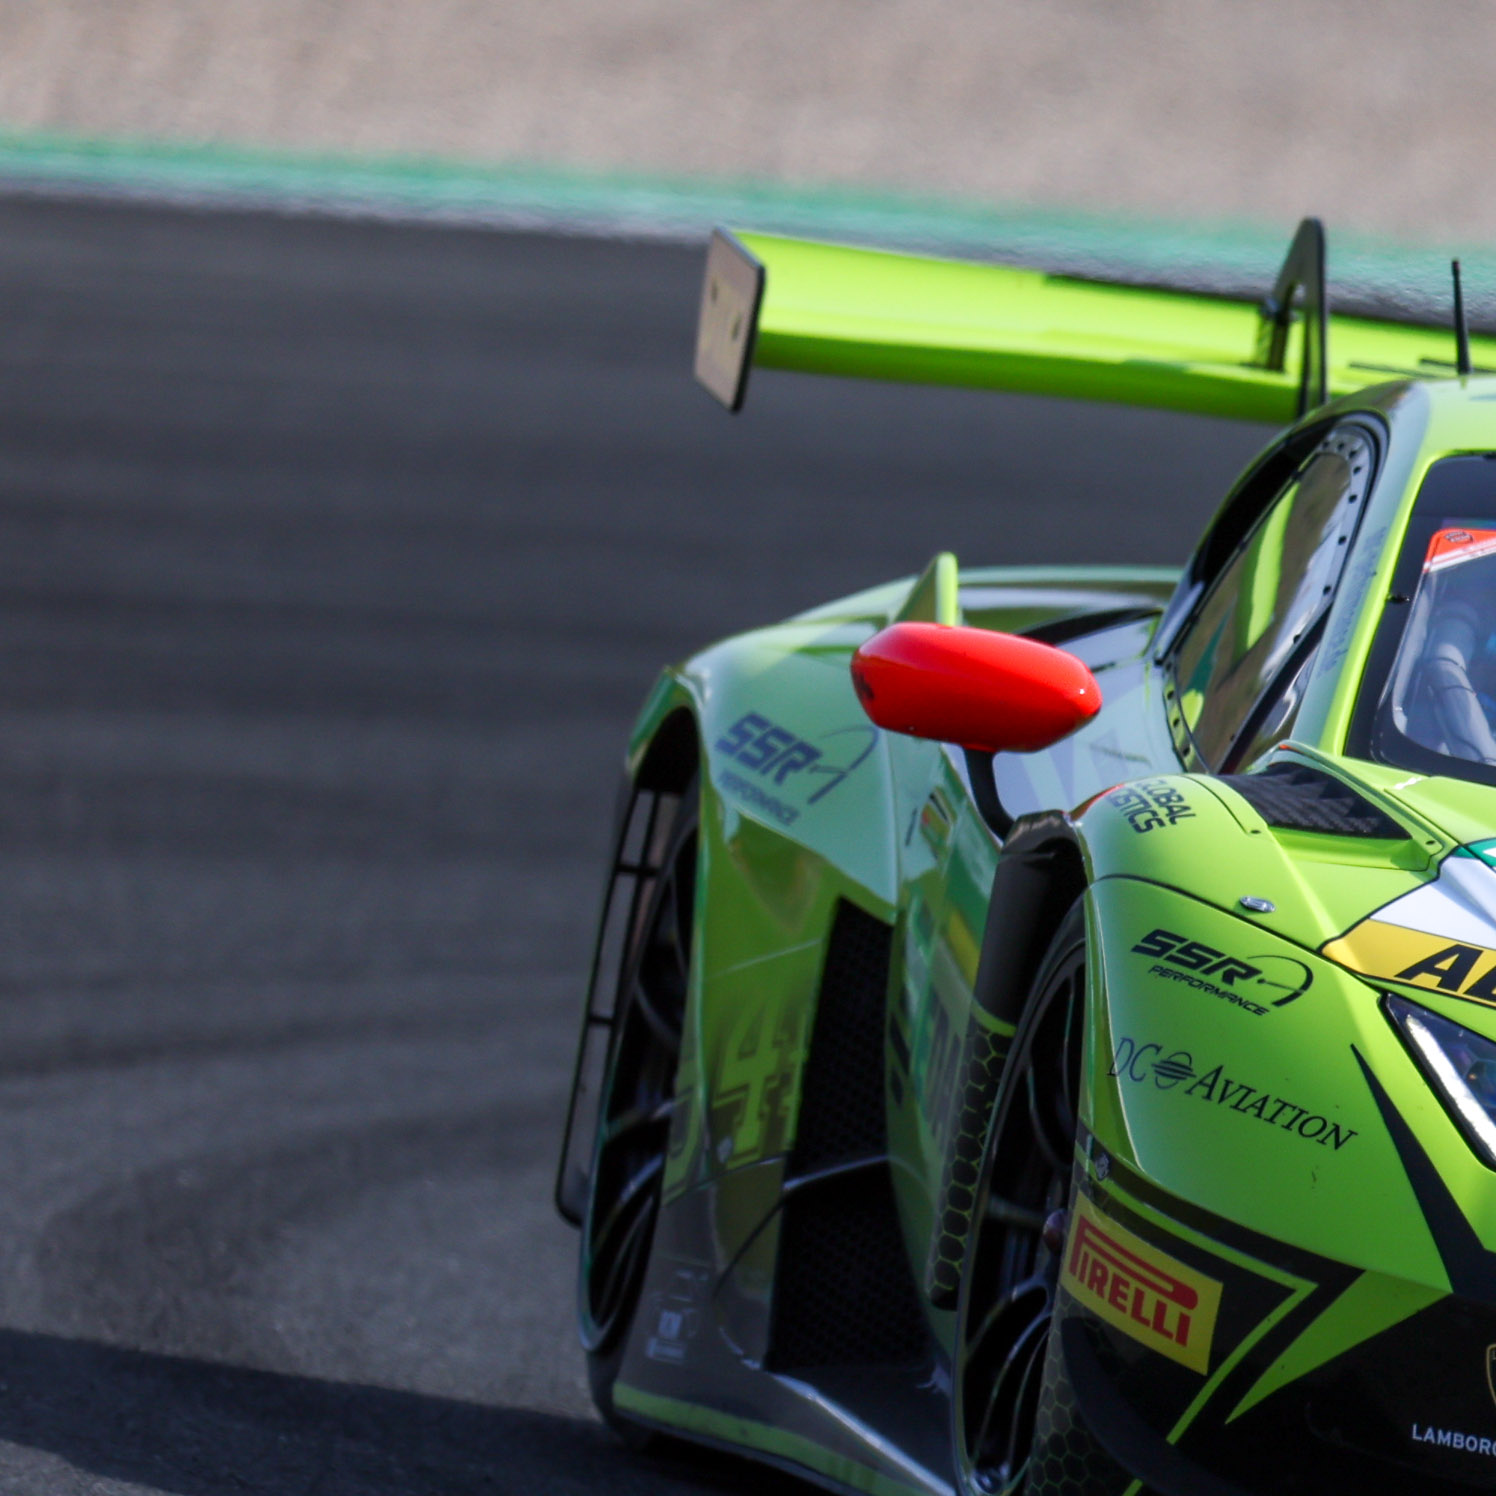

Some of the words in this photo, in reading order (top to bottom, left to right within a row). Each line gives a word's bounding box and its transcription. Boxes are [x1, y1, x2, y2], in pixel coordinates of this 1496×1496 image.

[715, 712, 823, 786] SSR
[1131, 928, 1263, 986] SSR
[1148, 965, 1270, 1016] PERFORMANCE
[1106, 1037, 1163, 1083] DC
[1184, 1065, 1359, 1150] AVIATION
[1069, 1214, 1199, 1348] PIRELLI
